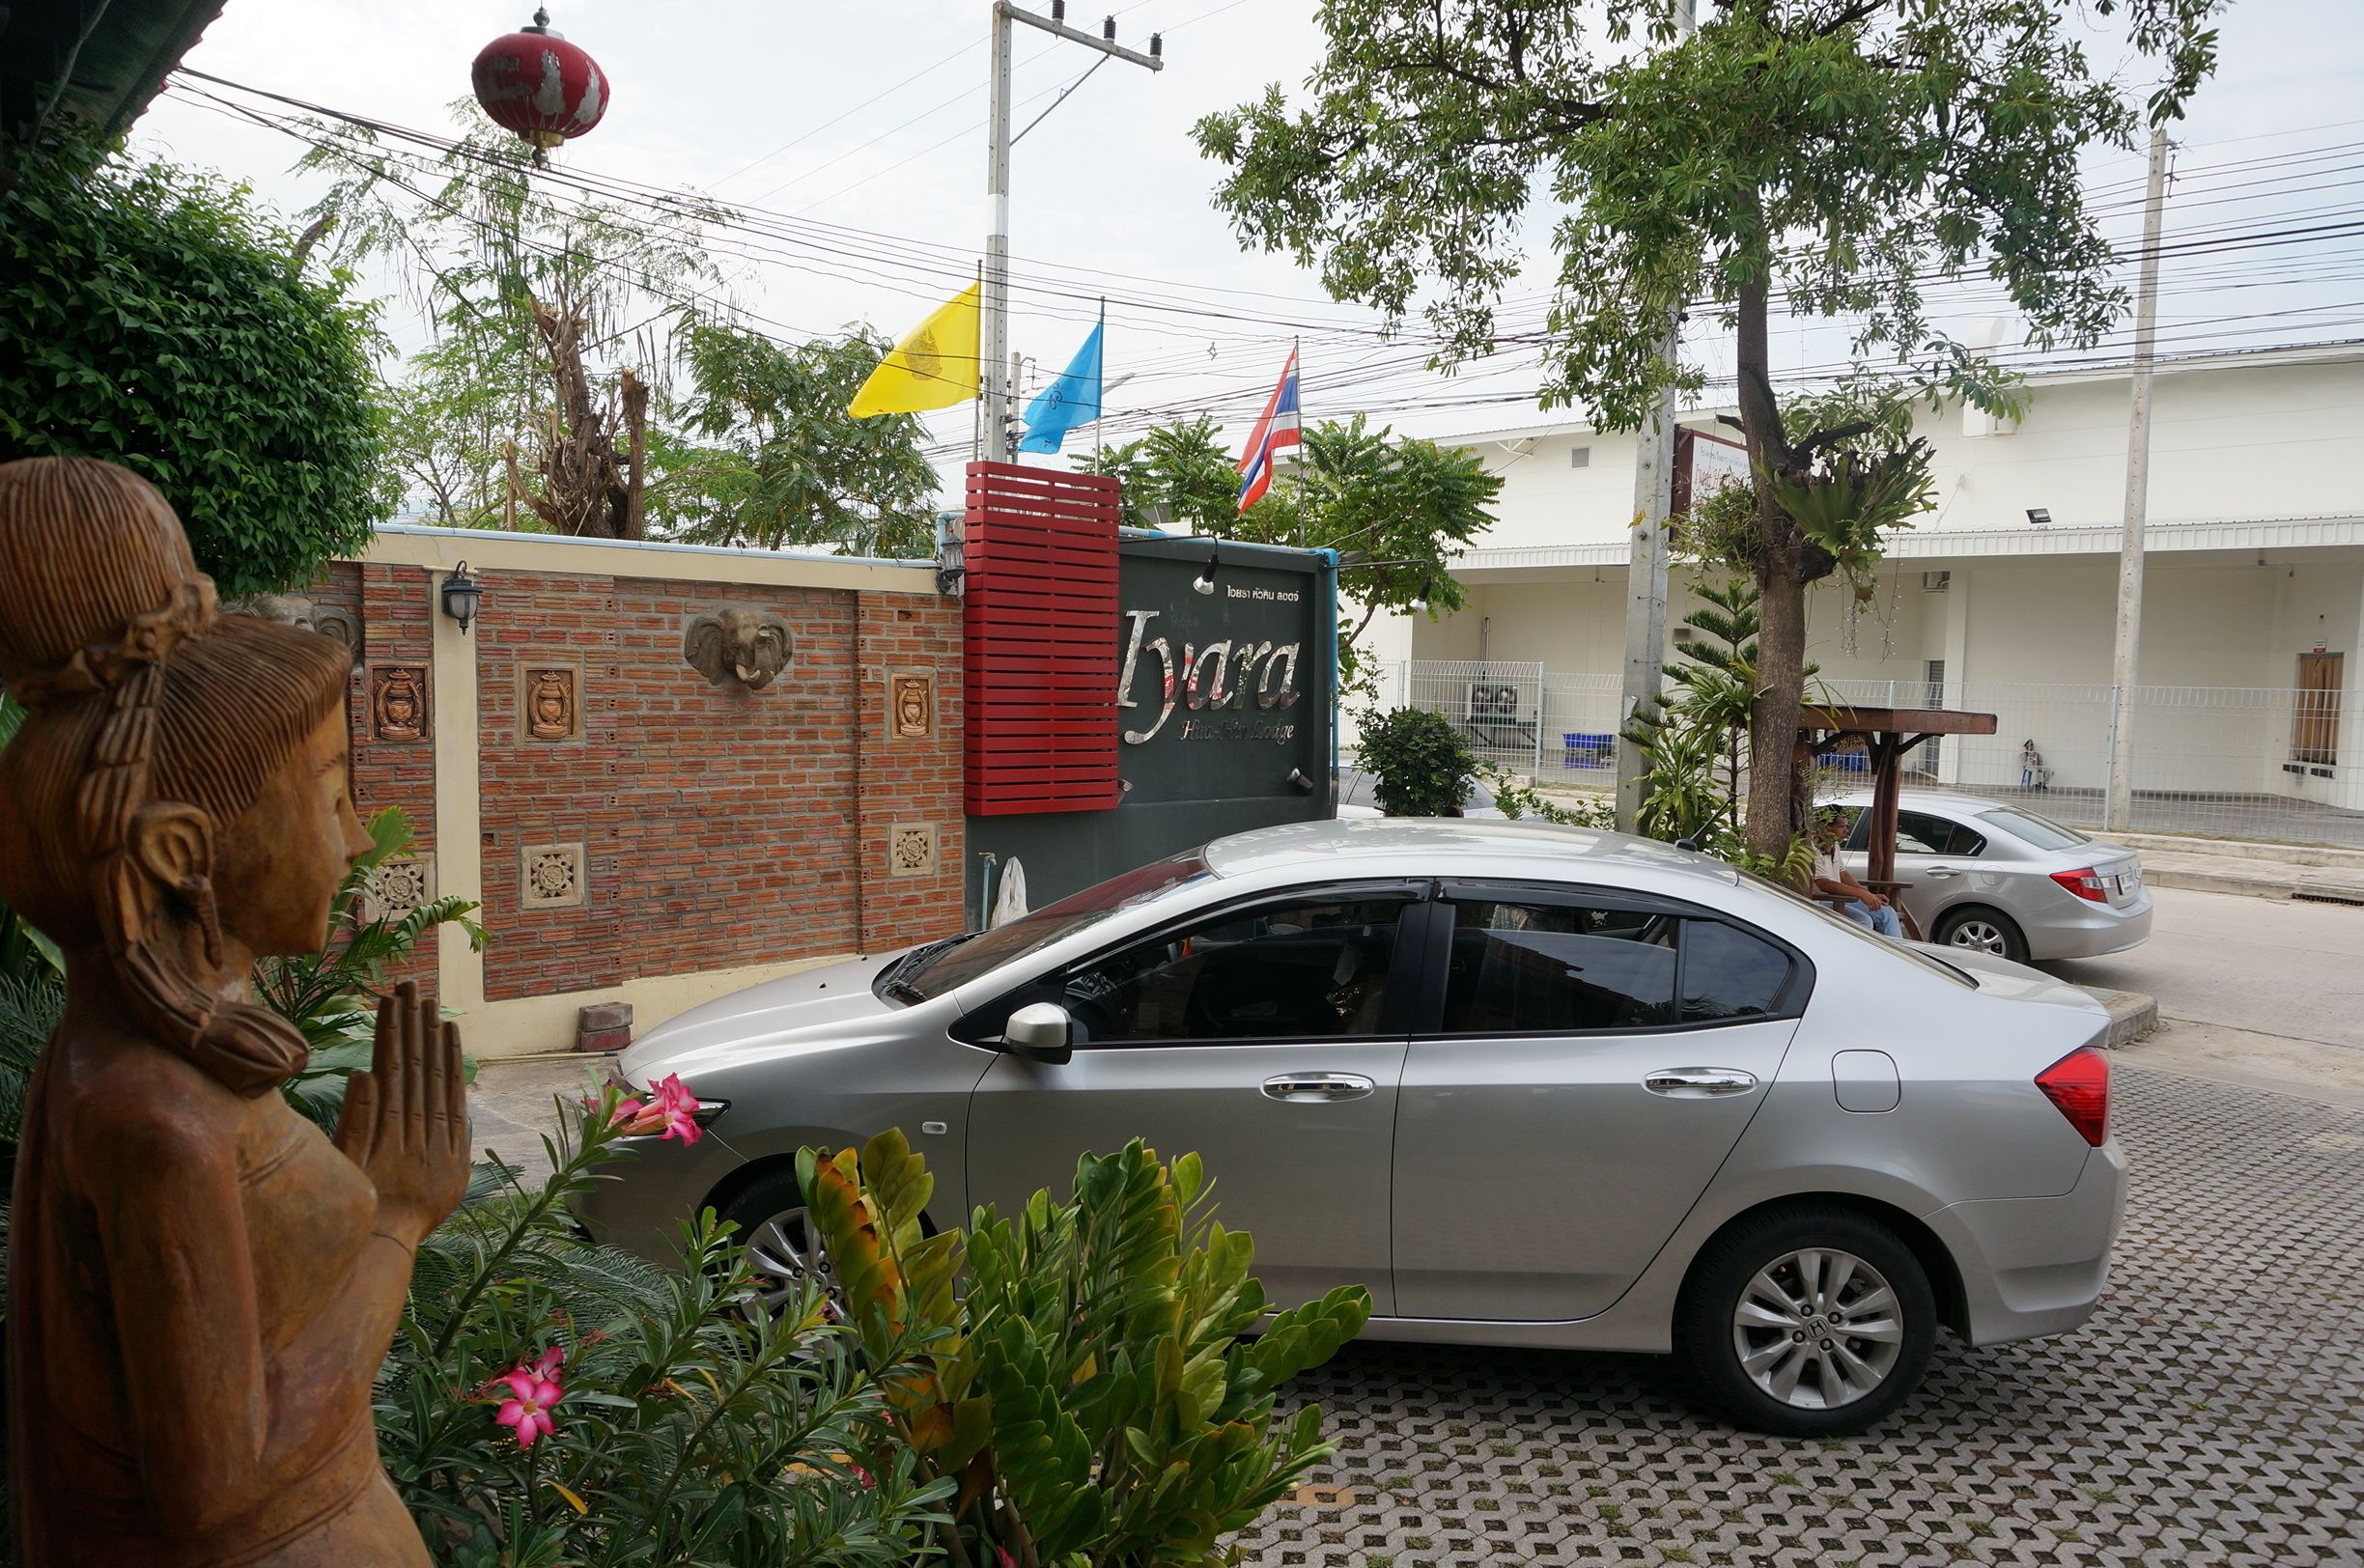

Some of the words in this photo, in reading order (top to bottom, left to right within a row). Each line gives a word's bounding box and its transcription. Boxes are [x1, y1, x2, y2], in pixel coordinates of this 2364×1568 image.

[1226, 584, 1251, 599] ไอยรา
[1252, 587, 1275, 601] หัวหิน
[1115, 610, 1301, 745] Iyara
[1251, 718, 1295, 745] Lodge
